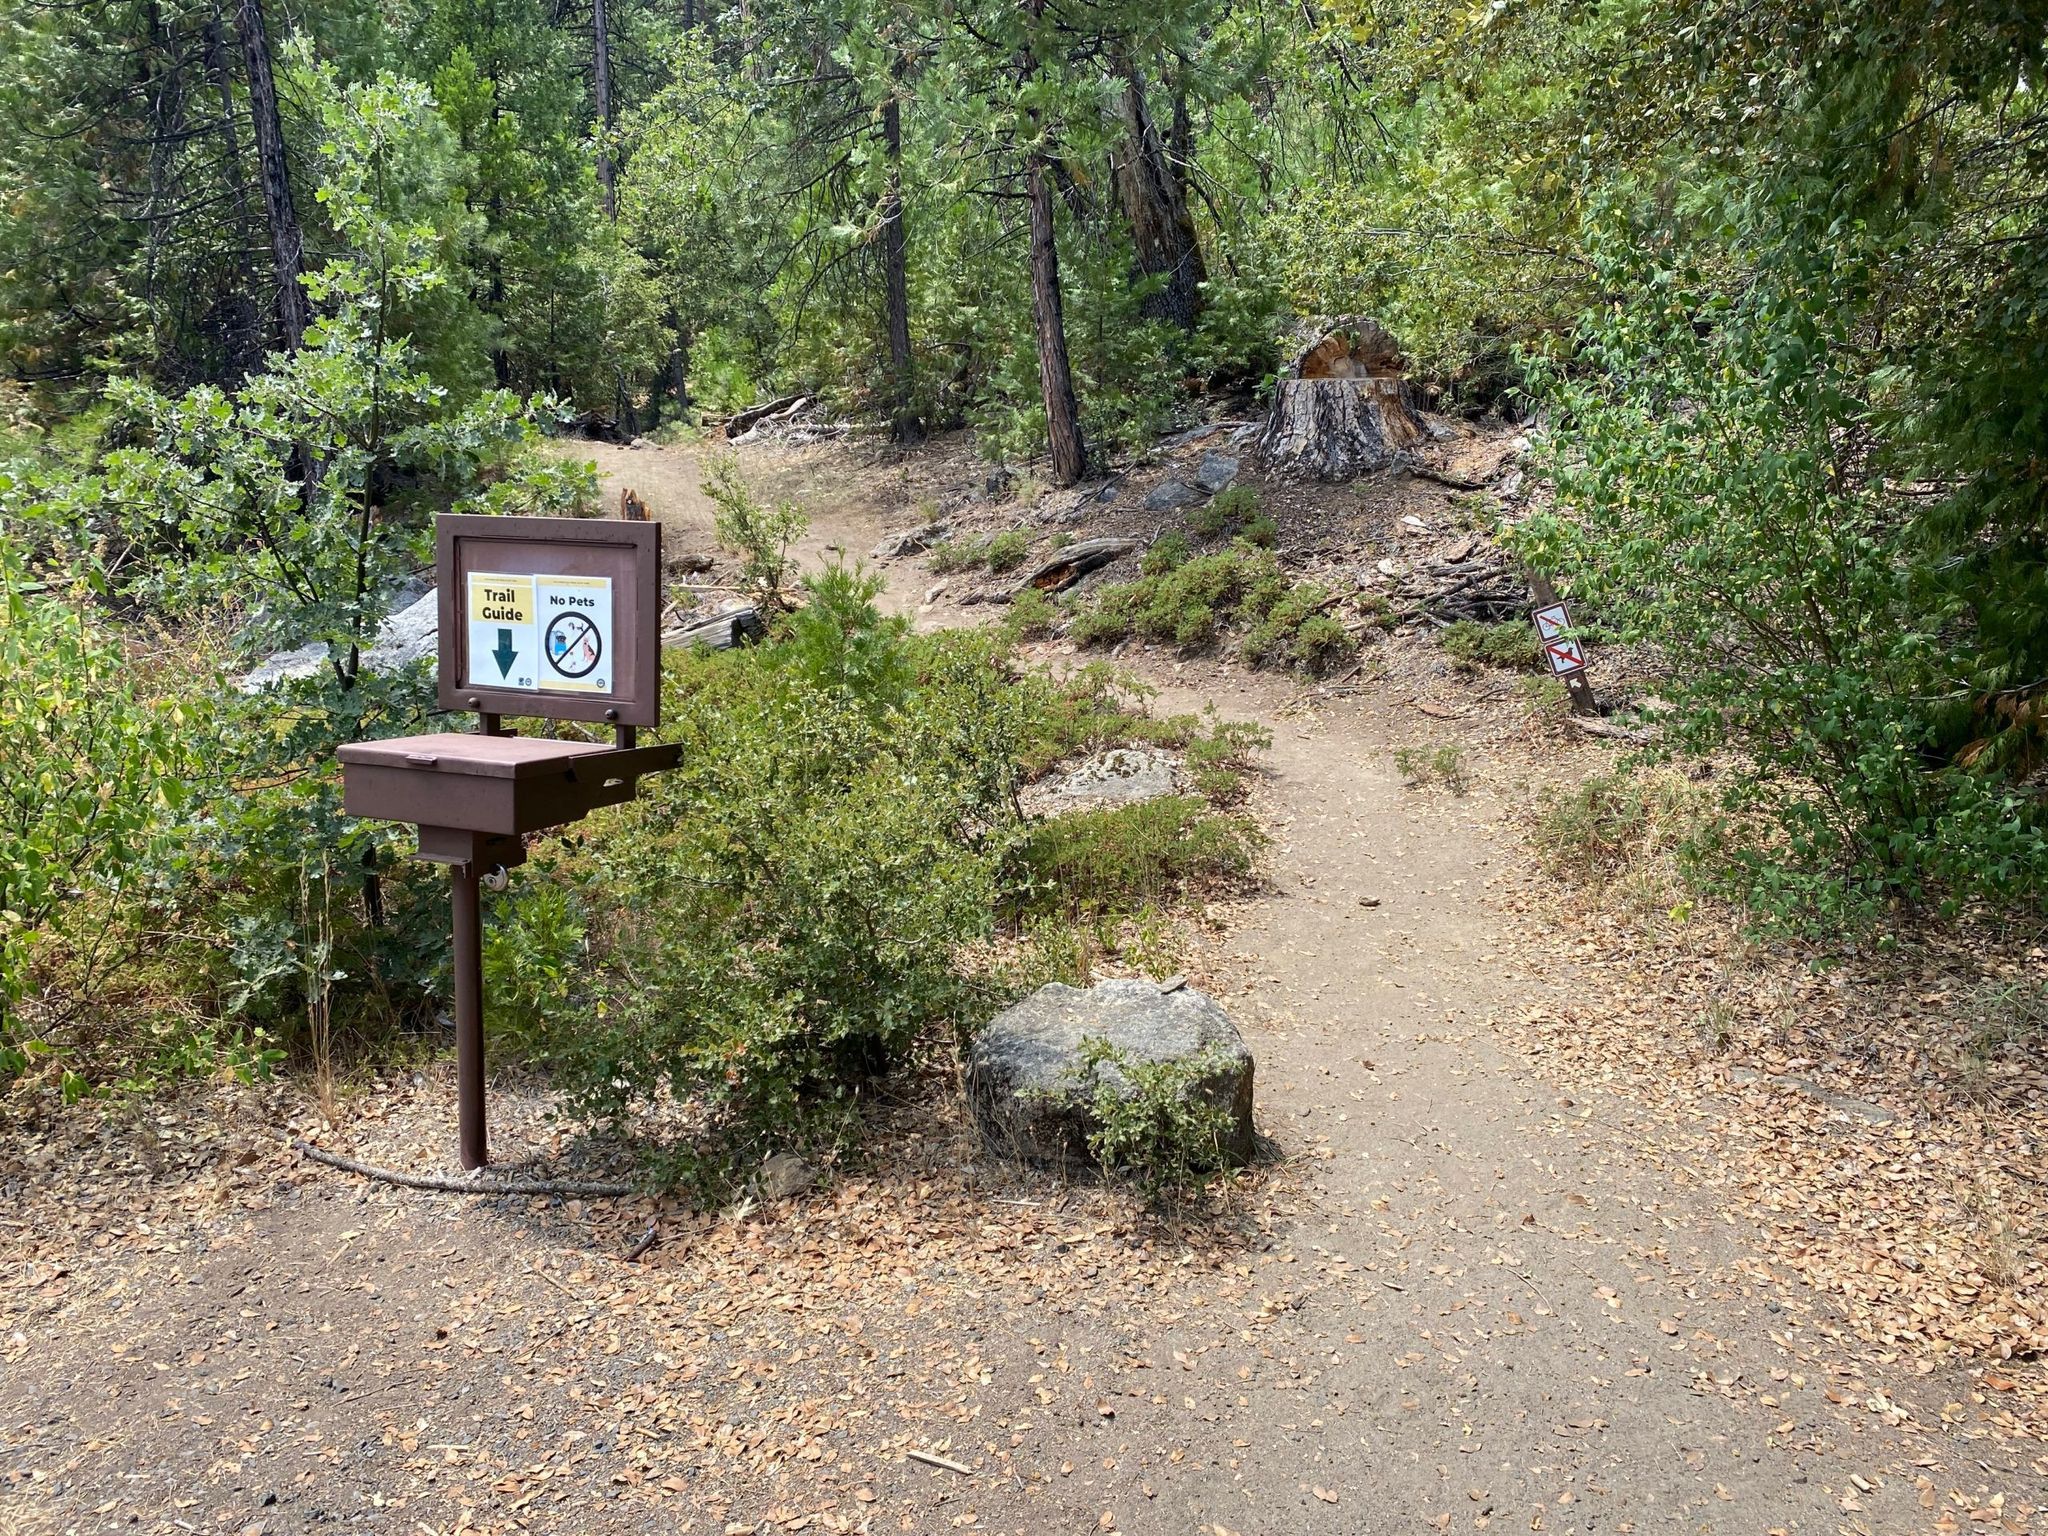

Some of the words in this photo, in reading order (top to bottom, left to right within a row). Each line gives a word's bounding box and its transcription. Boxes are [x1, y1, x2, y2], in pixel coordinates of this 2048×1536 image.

[484, 589, 515, 603] Trail
[550, 595, 565, 606] No
[569, 597, 595, 607] Pets
[482, 607, 523, 621] Guide
